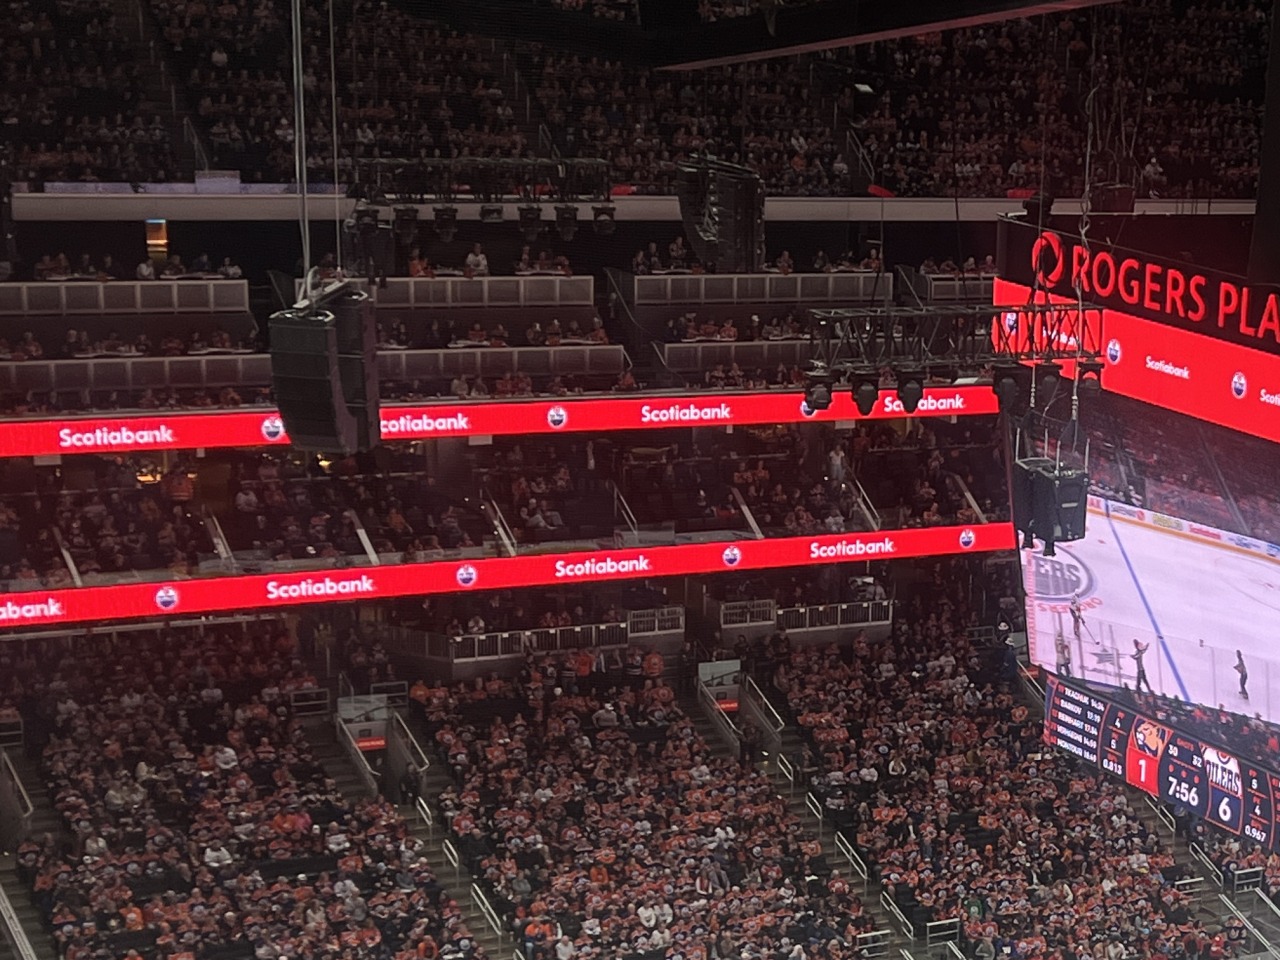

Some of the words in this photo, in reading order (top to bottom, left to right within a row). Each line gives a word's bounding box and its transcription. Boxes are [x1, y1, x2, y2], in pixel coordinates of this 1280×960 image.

[1072, 245, 1206, 321] ROGERS
[1145, 356, 1191, 380] Scotiabank
[380, 412, 468, 433] cotiabank
[641, 403, 731, 422] Scotiabank
[59, 425, 173, 447] Scotiabank
[810, 538, 894, 558] Scotiabank
[555, 556, 649, 578] Scotiabank
[266, 576, 374, 598] Scotiabank
[1168, 744, 1178, 757] 30
[1192, 755, 1202, 768] 32
[1138, 759, 1146, 783] 1
[1168, 776, 1199, 806] 7:56
[1218, 796, 1231, 821] 6
[1244, 824, 1267, 842] 0.967
